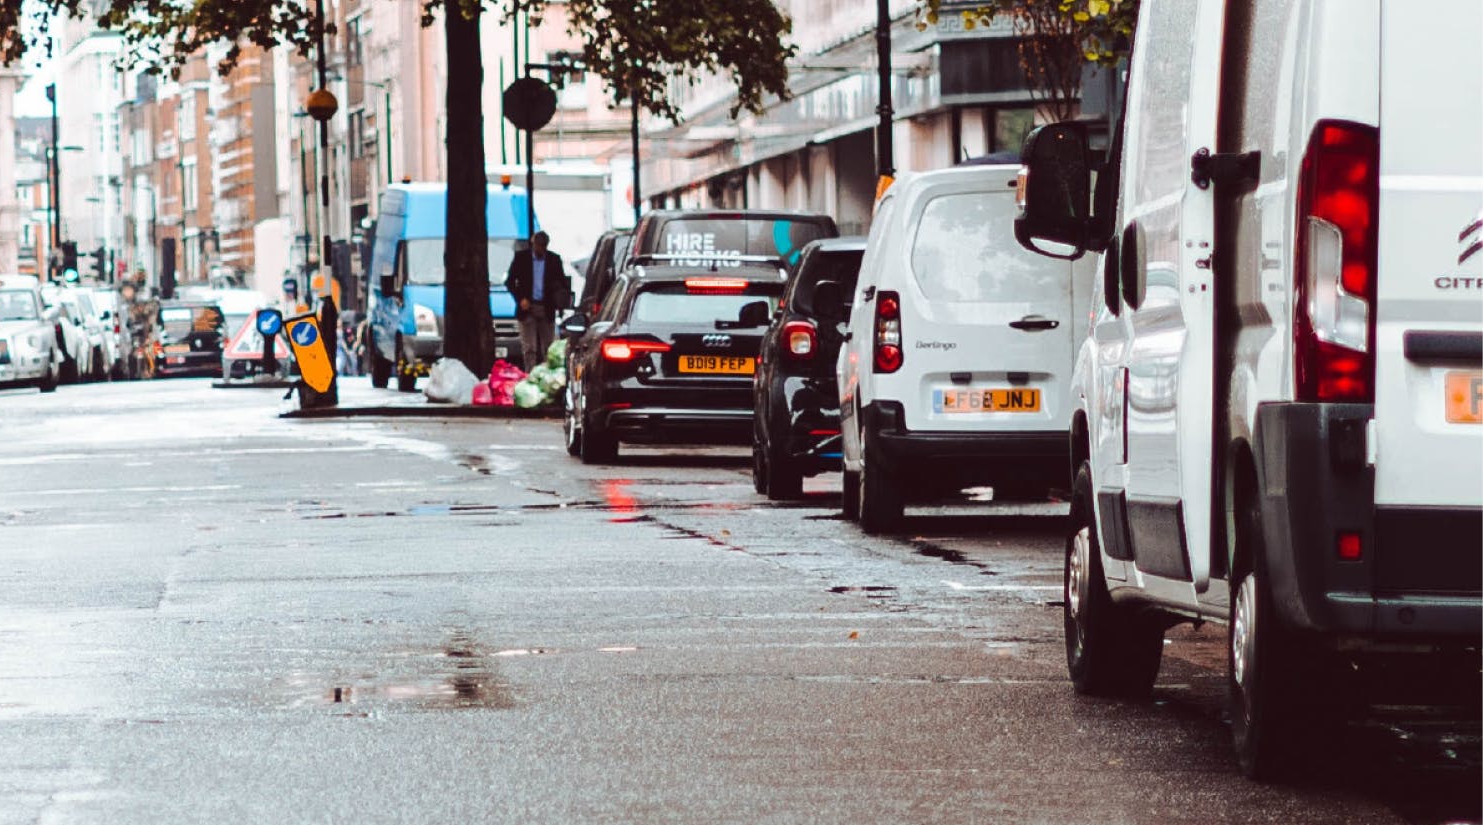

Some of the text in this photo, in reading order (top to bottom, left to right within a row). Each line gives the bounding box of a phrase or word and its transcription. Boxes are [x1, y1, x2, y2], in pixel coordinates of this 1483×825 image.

[666, 232, 716, 250] HIRE
[667, 249, 741, 267] WORKS
[915, 341, 957, 351] Berlingo
[687, 357, 746, 370] BD19 FEP
[999, 391, 1035, 408] JNJ
